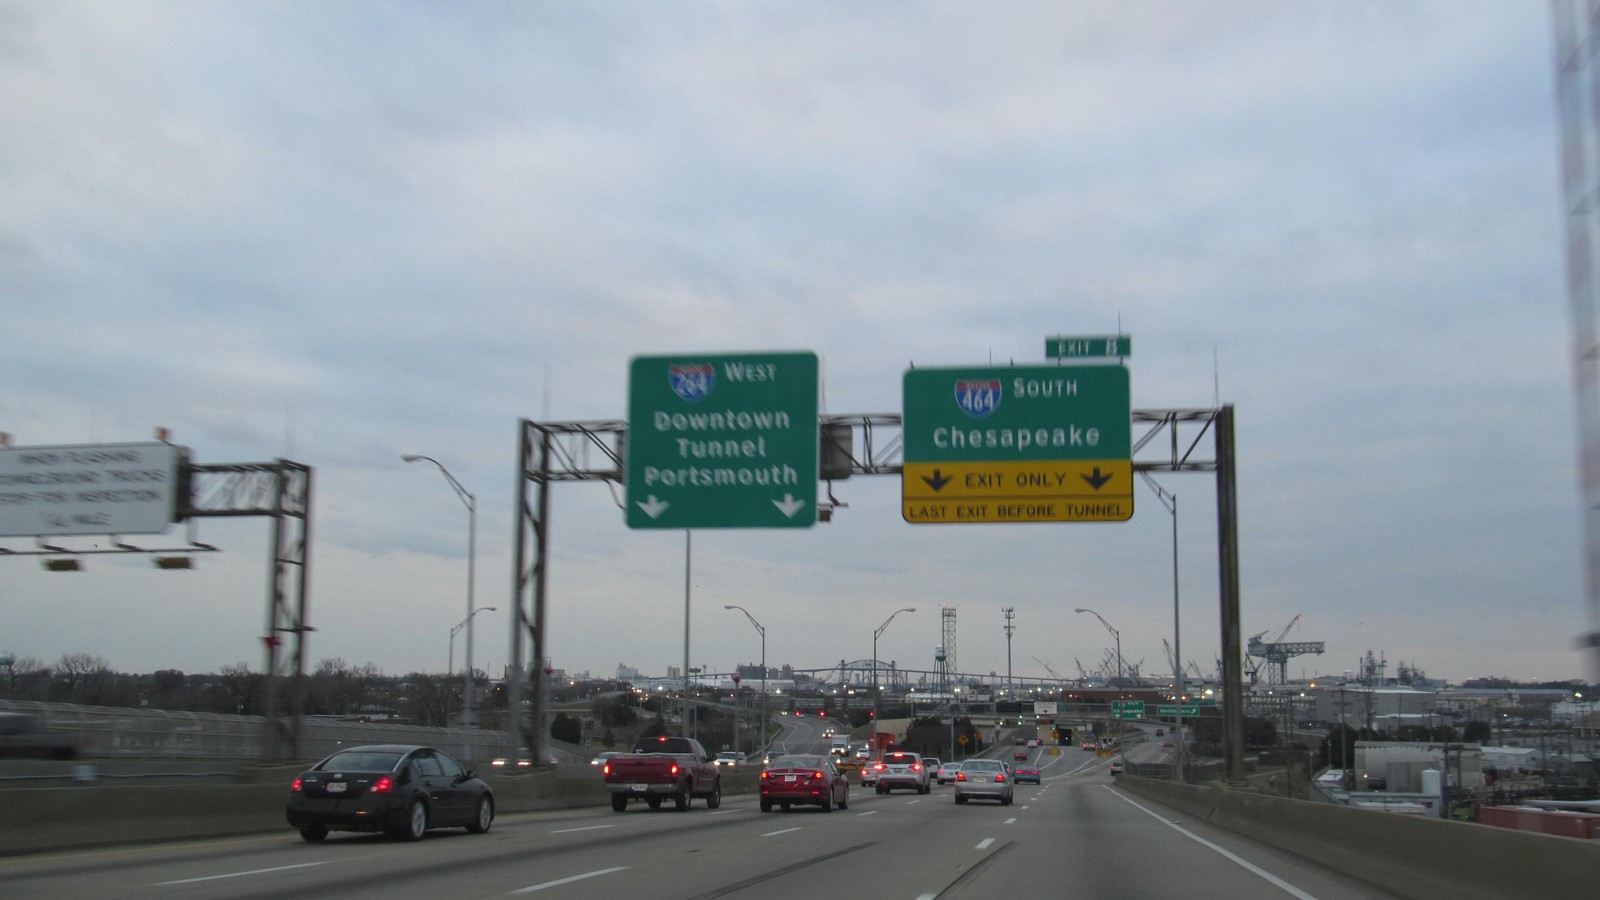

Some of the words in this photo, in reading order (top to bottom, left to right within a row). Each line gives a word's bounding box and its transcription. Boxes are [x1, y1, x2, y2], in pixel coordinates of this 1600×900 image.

[1058, 339, 1091, 356] EXIT
[724, 361, 777, 382] WEST
[962, 387, 994, 411] 464
[1014, 378, 1077, 398] SOUTH
[654, 410, 790, 431] Downtown
[676, 435, 767, 458] Tunnel
[934, 425, 1099, 451] Chesapeake
[644, 464, 798, 486] Portsmouth
[965, 473, 1004, 488] EXIT
[1016, 472, 1066, 487] ONLY
[909, 505, 948, 519] LAST
[956, 504, 989, 518] EXIT
[998, 504, 1058, 517] BEFORE
[1066, 503, 1126, 517] TUNNEL
